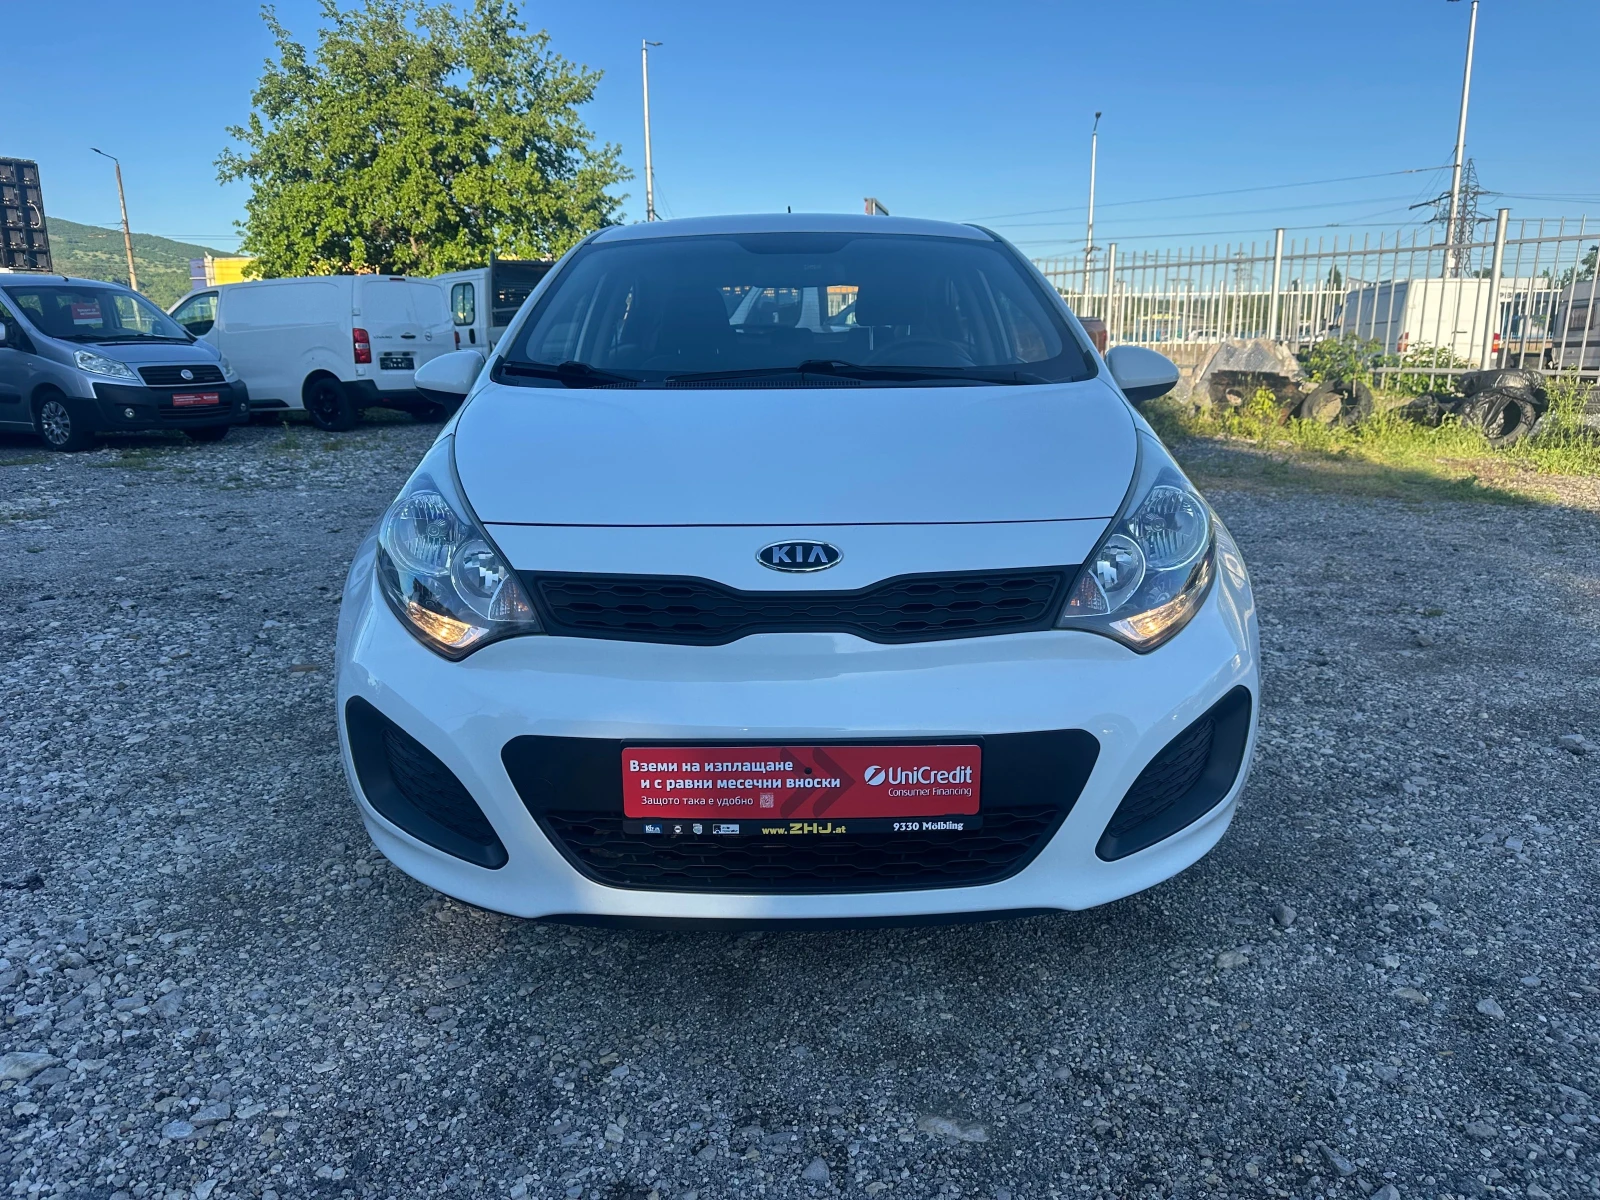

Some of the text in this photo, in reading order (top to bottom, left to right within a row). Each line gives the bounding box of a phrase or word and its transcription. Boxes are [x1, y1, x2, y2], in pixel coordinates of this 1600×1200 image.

[771, 545, 829, 563] KIA
[629, 759, 793, 774] Вземи на изплащане
[888, 765, 972, 785] UniCredit
[640, 777, 841, 791] и с равни месечни вноски
[888, 787, 972, 797] Consumer Financing
[641, 795, 754, 807] Защото така е удобно
[893, 821, 964, 831] 9330 Mölbling
